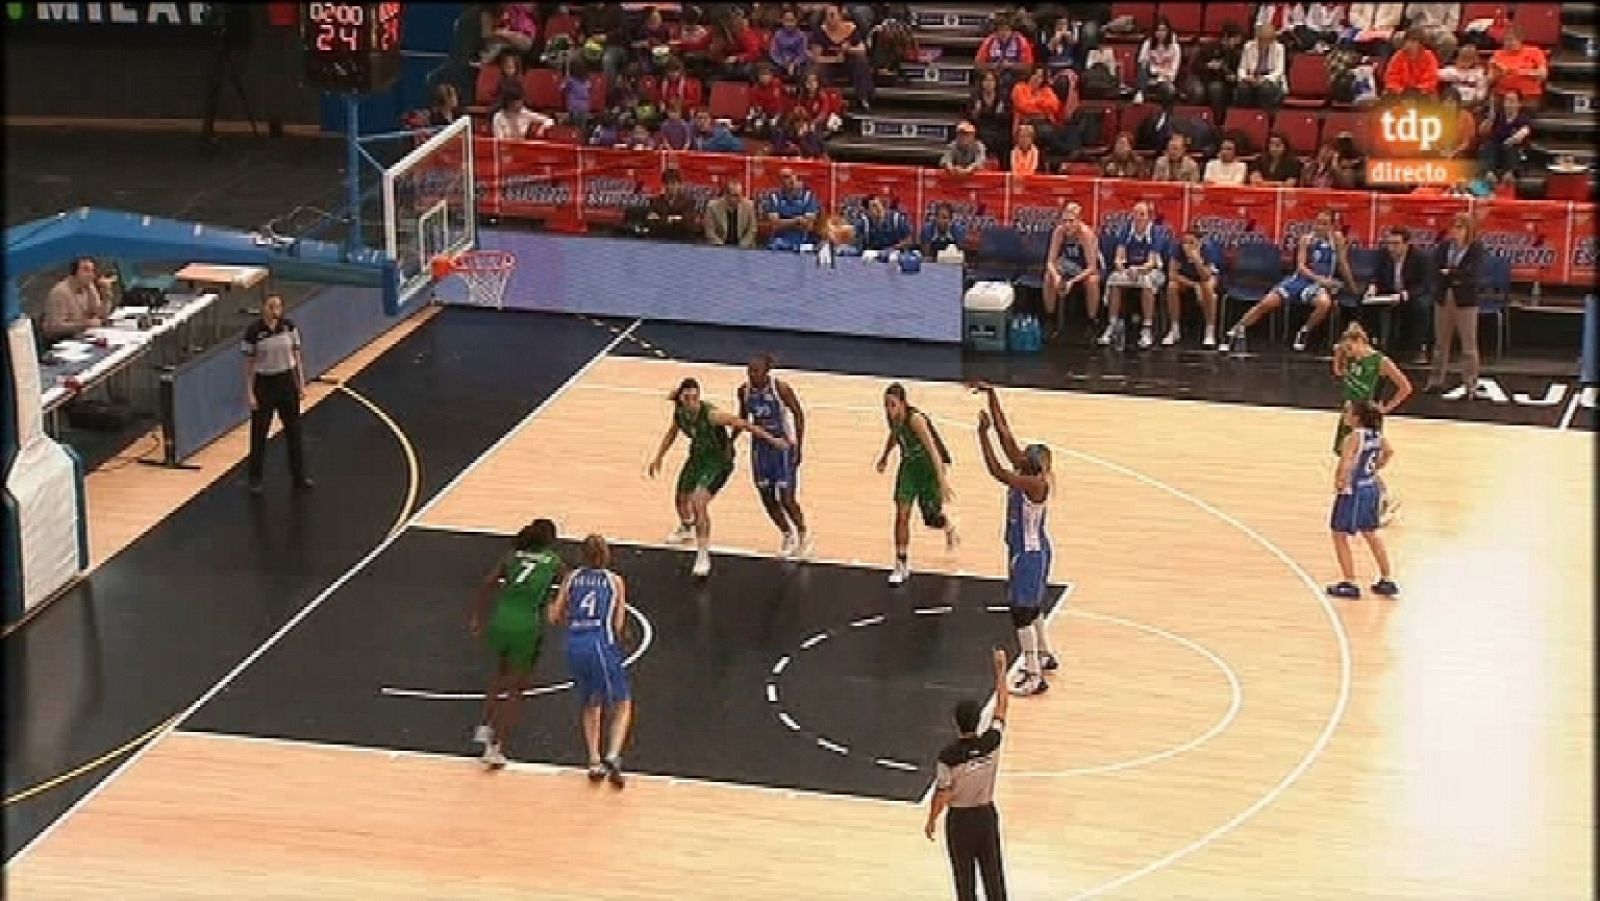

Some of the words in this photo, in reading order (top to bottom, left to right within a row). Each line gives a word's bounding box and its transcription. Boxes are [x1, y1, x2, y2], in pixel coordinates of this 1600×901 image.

[316, 24, 358, 51] 24
[515, 560, 537, 583] 7
[579, 589, 598, 618] 4
